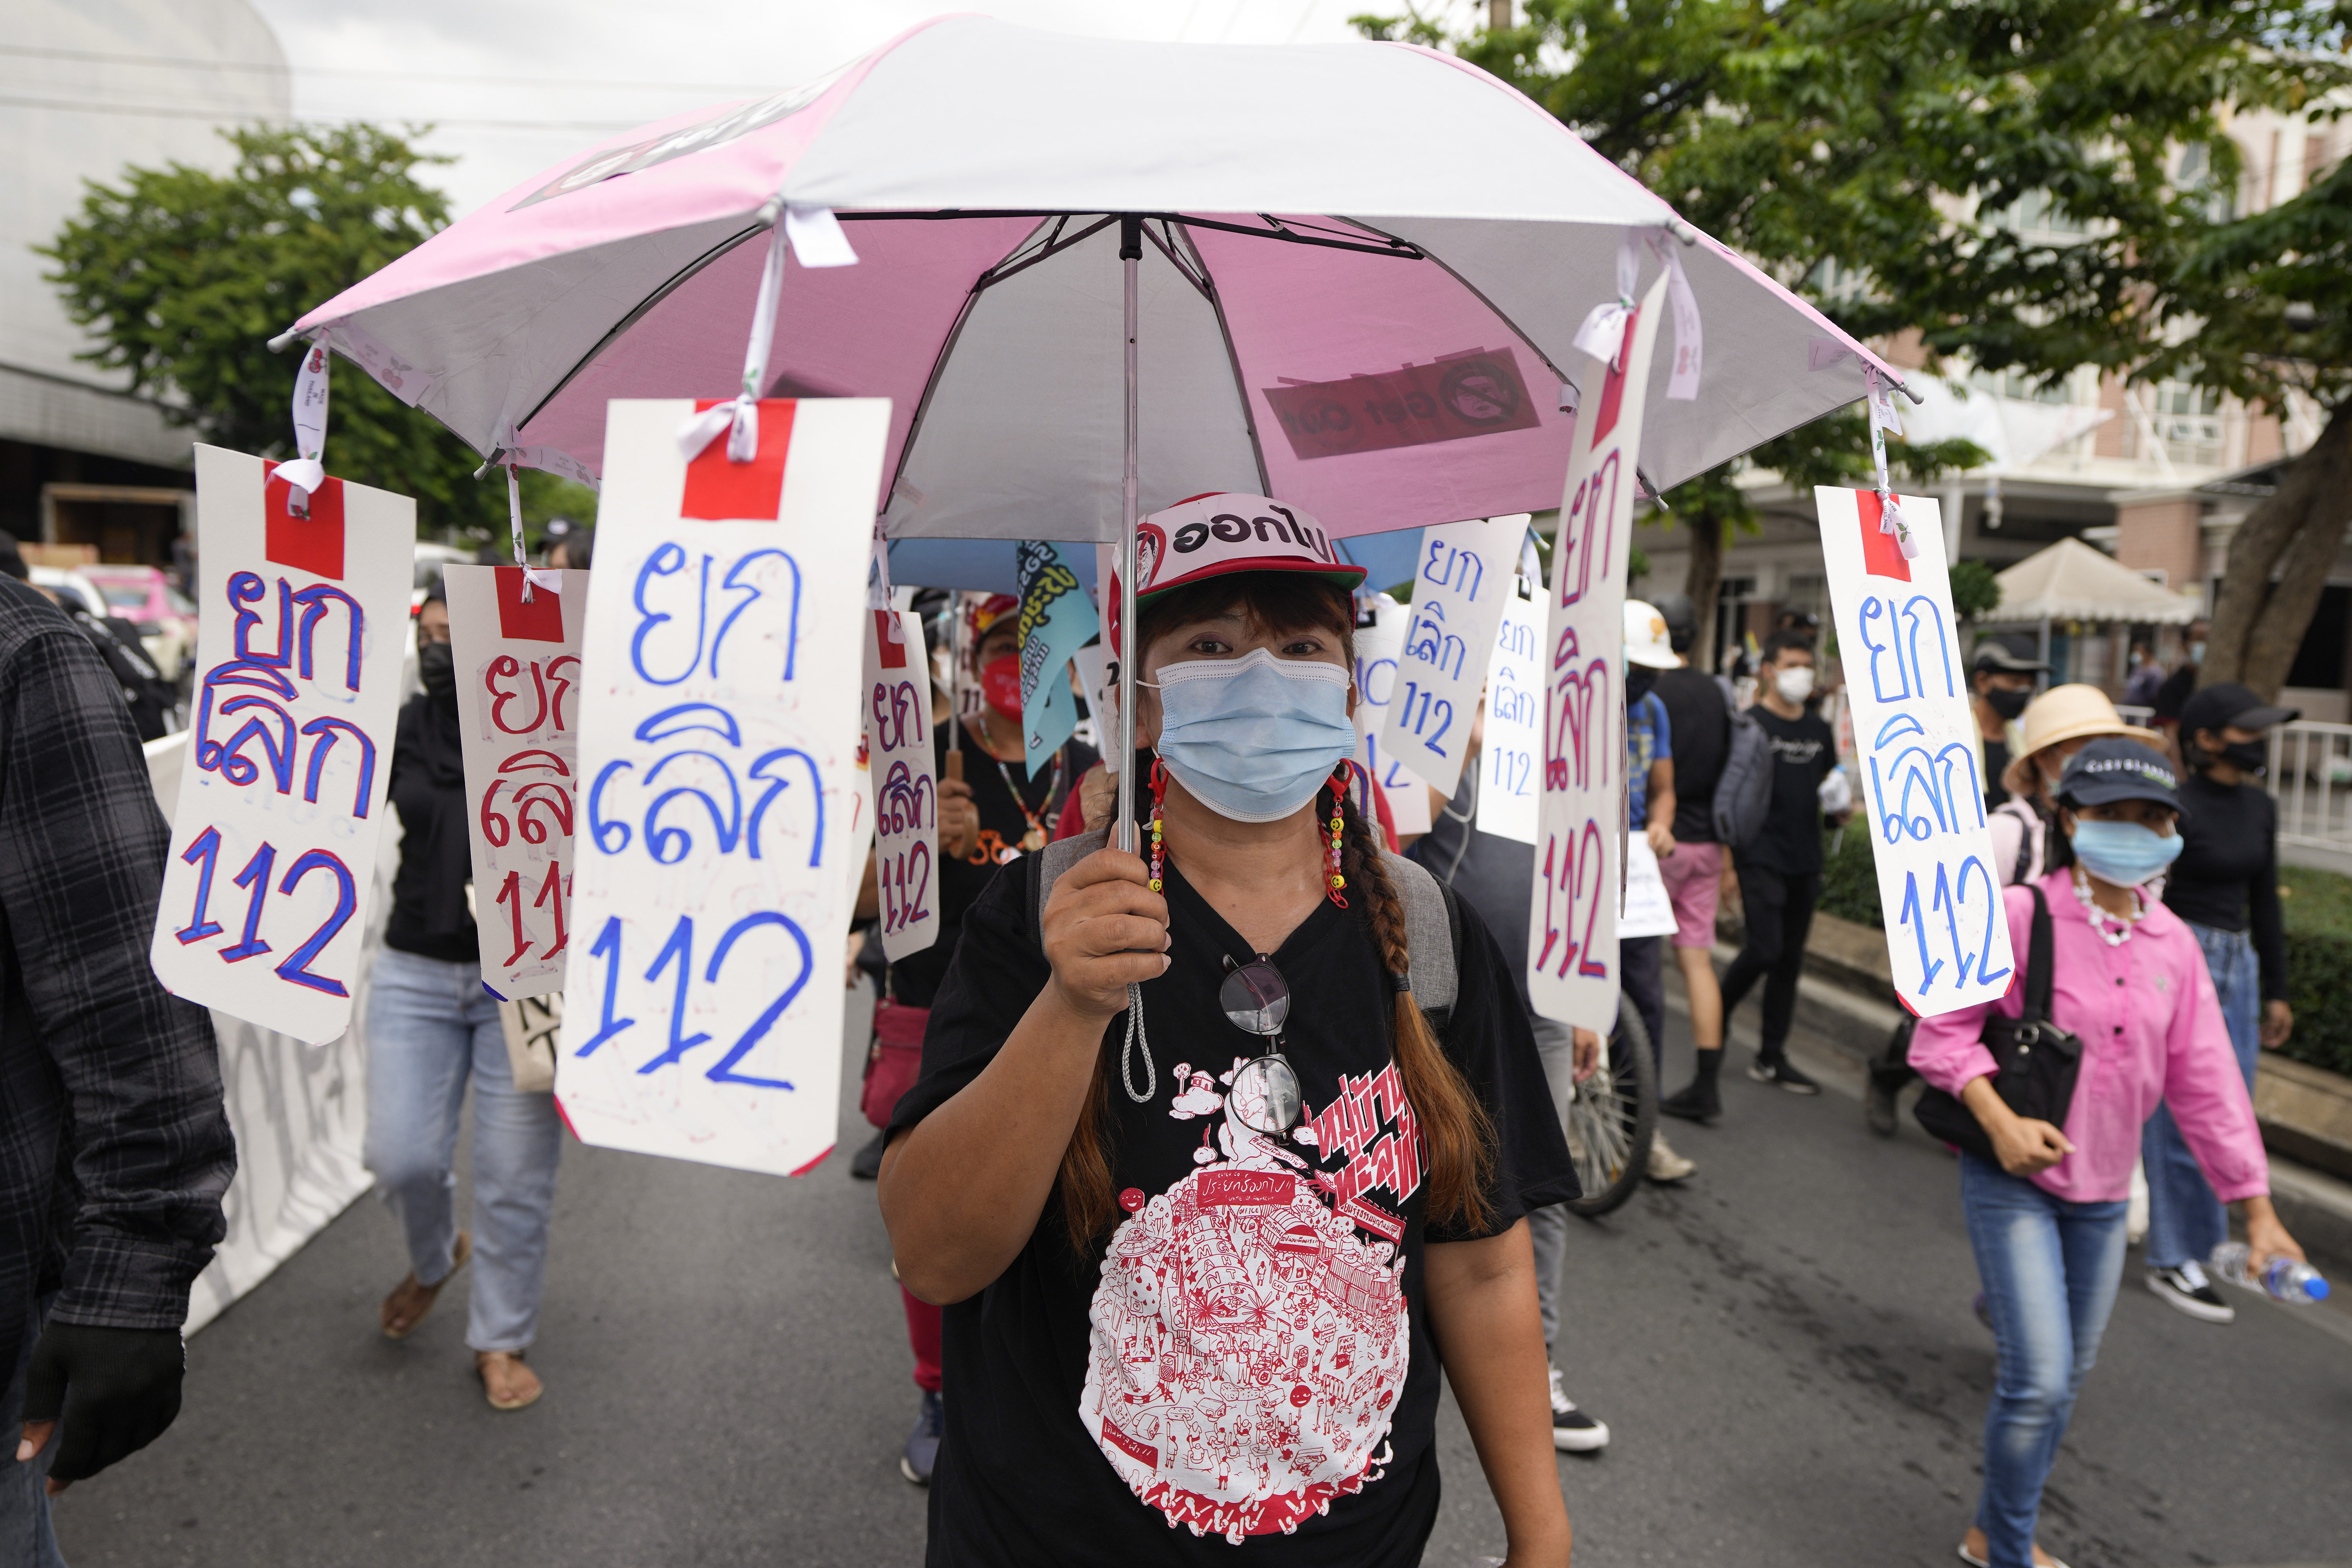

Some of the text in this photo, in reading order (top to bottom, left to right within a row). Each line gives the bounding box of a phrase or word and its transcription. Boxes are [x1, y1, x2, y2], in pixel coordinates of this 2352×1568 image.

[1173, 505, 1331, 563] ออกไป
[1424, 539, 1483, 602] ยก
[1562, 446, 1620, 609] ยก
[227, 571, 363, 693] ยก
[632, 541, 801, 686] ยก
[1406, 601, 1466, 681] เลิก
[1499, 619, 1535, 662] ยก
[1859, 594, 1955, 704] ยก
[197, 660, 376, 819] เลิก
[873, 680, 923, 752] ยก
[1400, 681, 1454, 759] 112
[1493, 667, 1535, 728] เลิก
[1546, 626, 1609, 791] เลิก
[481, 750, 579, 848] เลิ
[588, 702, 824, 868] เลิก
[878, 760, 934, 837] เลิก
[1493, 746, 1532, 797] 112
[1869, 713, 1986, 845] เลิก
[175, 825, 357, 998] 112
[495, 860, 573, 967] 11
[882, 840, 929, 933] 112
[1536, 818, 1609, 980] 112
[1900, 855, 2011, 996] 112
[575, 910, 813, 1091] 112
[1273, 1283, 1285, 1291] CAFE
[1339, 1337, 1354, 1345] FUCK
[1344, 1443, 1362, 1470] WALKING
